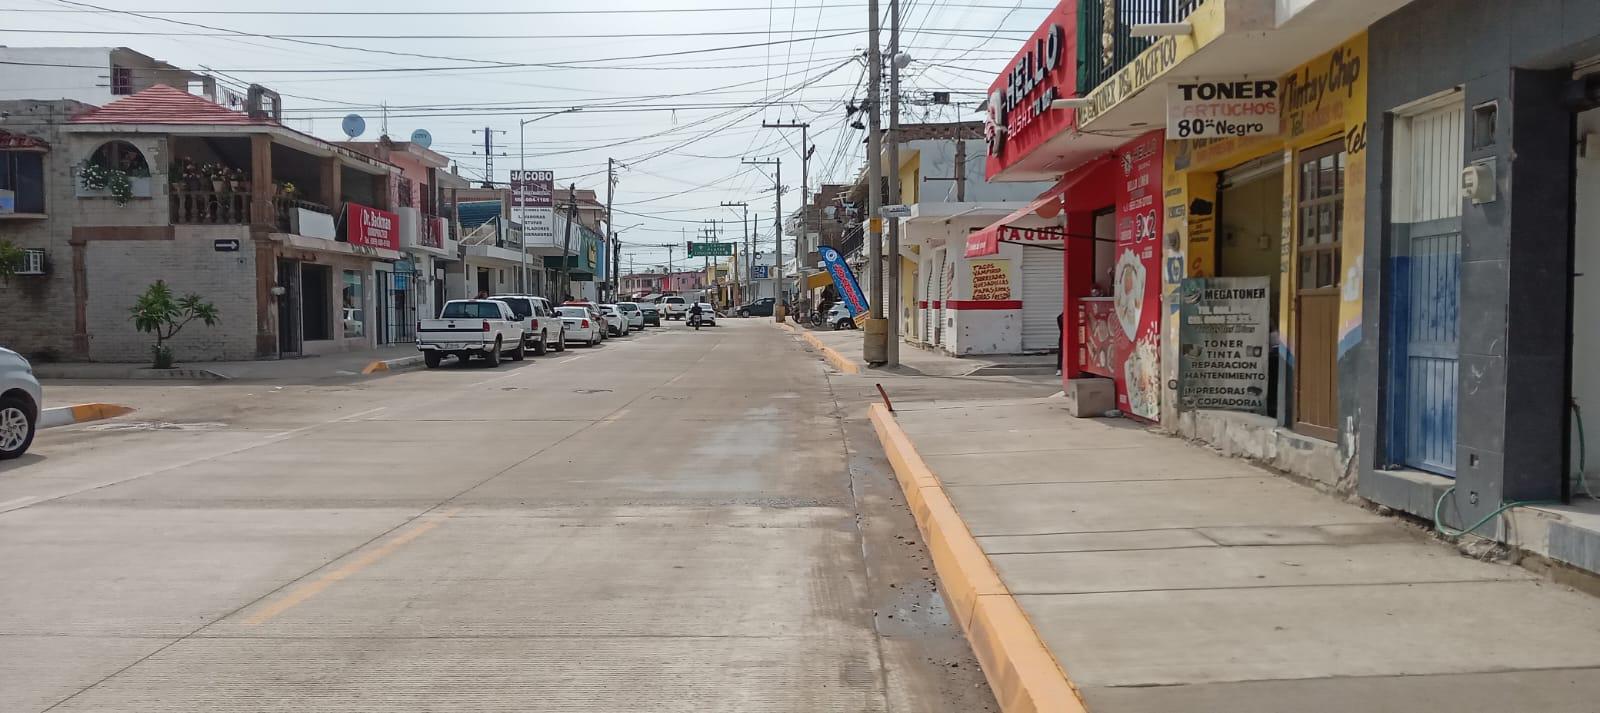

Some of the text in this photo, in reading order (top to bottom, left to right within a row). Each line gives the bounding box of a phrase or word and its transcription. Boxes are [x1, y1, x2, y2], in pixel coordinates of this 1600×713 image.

[1006, 24, 1062, 113] HELLO
[1329, 46, 1360, 98] Chip
[1178, 80, 1278, 101] TONER
[1174, 102, 1277, 118] ARTUCHOS
[1008, 106, 1032, 141] SUSHI
[1216, 120, 1264, 137] Negro
[998, 226, 1064, 242] TAQUE
[973, 263, 995, 271] TACOS
[1204, 288, 1266, 300] MEGATONER
[1204, 340, 1244, 348] TONER
[1207, 350, 1241, 358] TINTA
[1191, 361, 1257, 369] REPARACION
[1184, 372, 1265, 380] MANTENIMIENTO
[1184, 386, 1245, 394] IMPRESORAS
[1197, 398, 1262, 406] COPIADORAS
